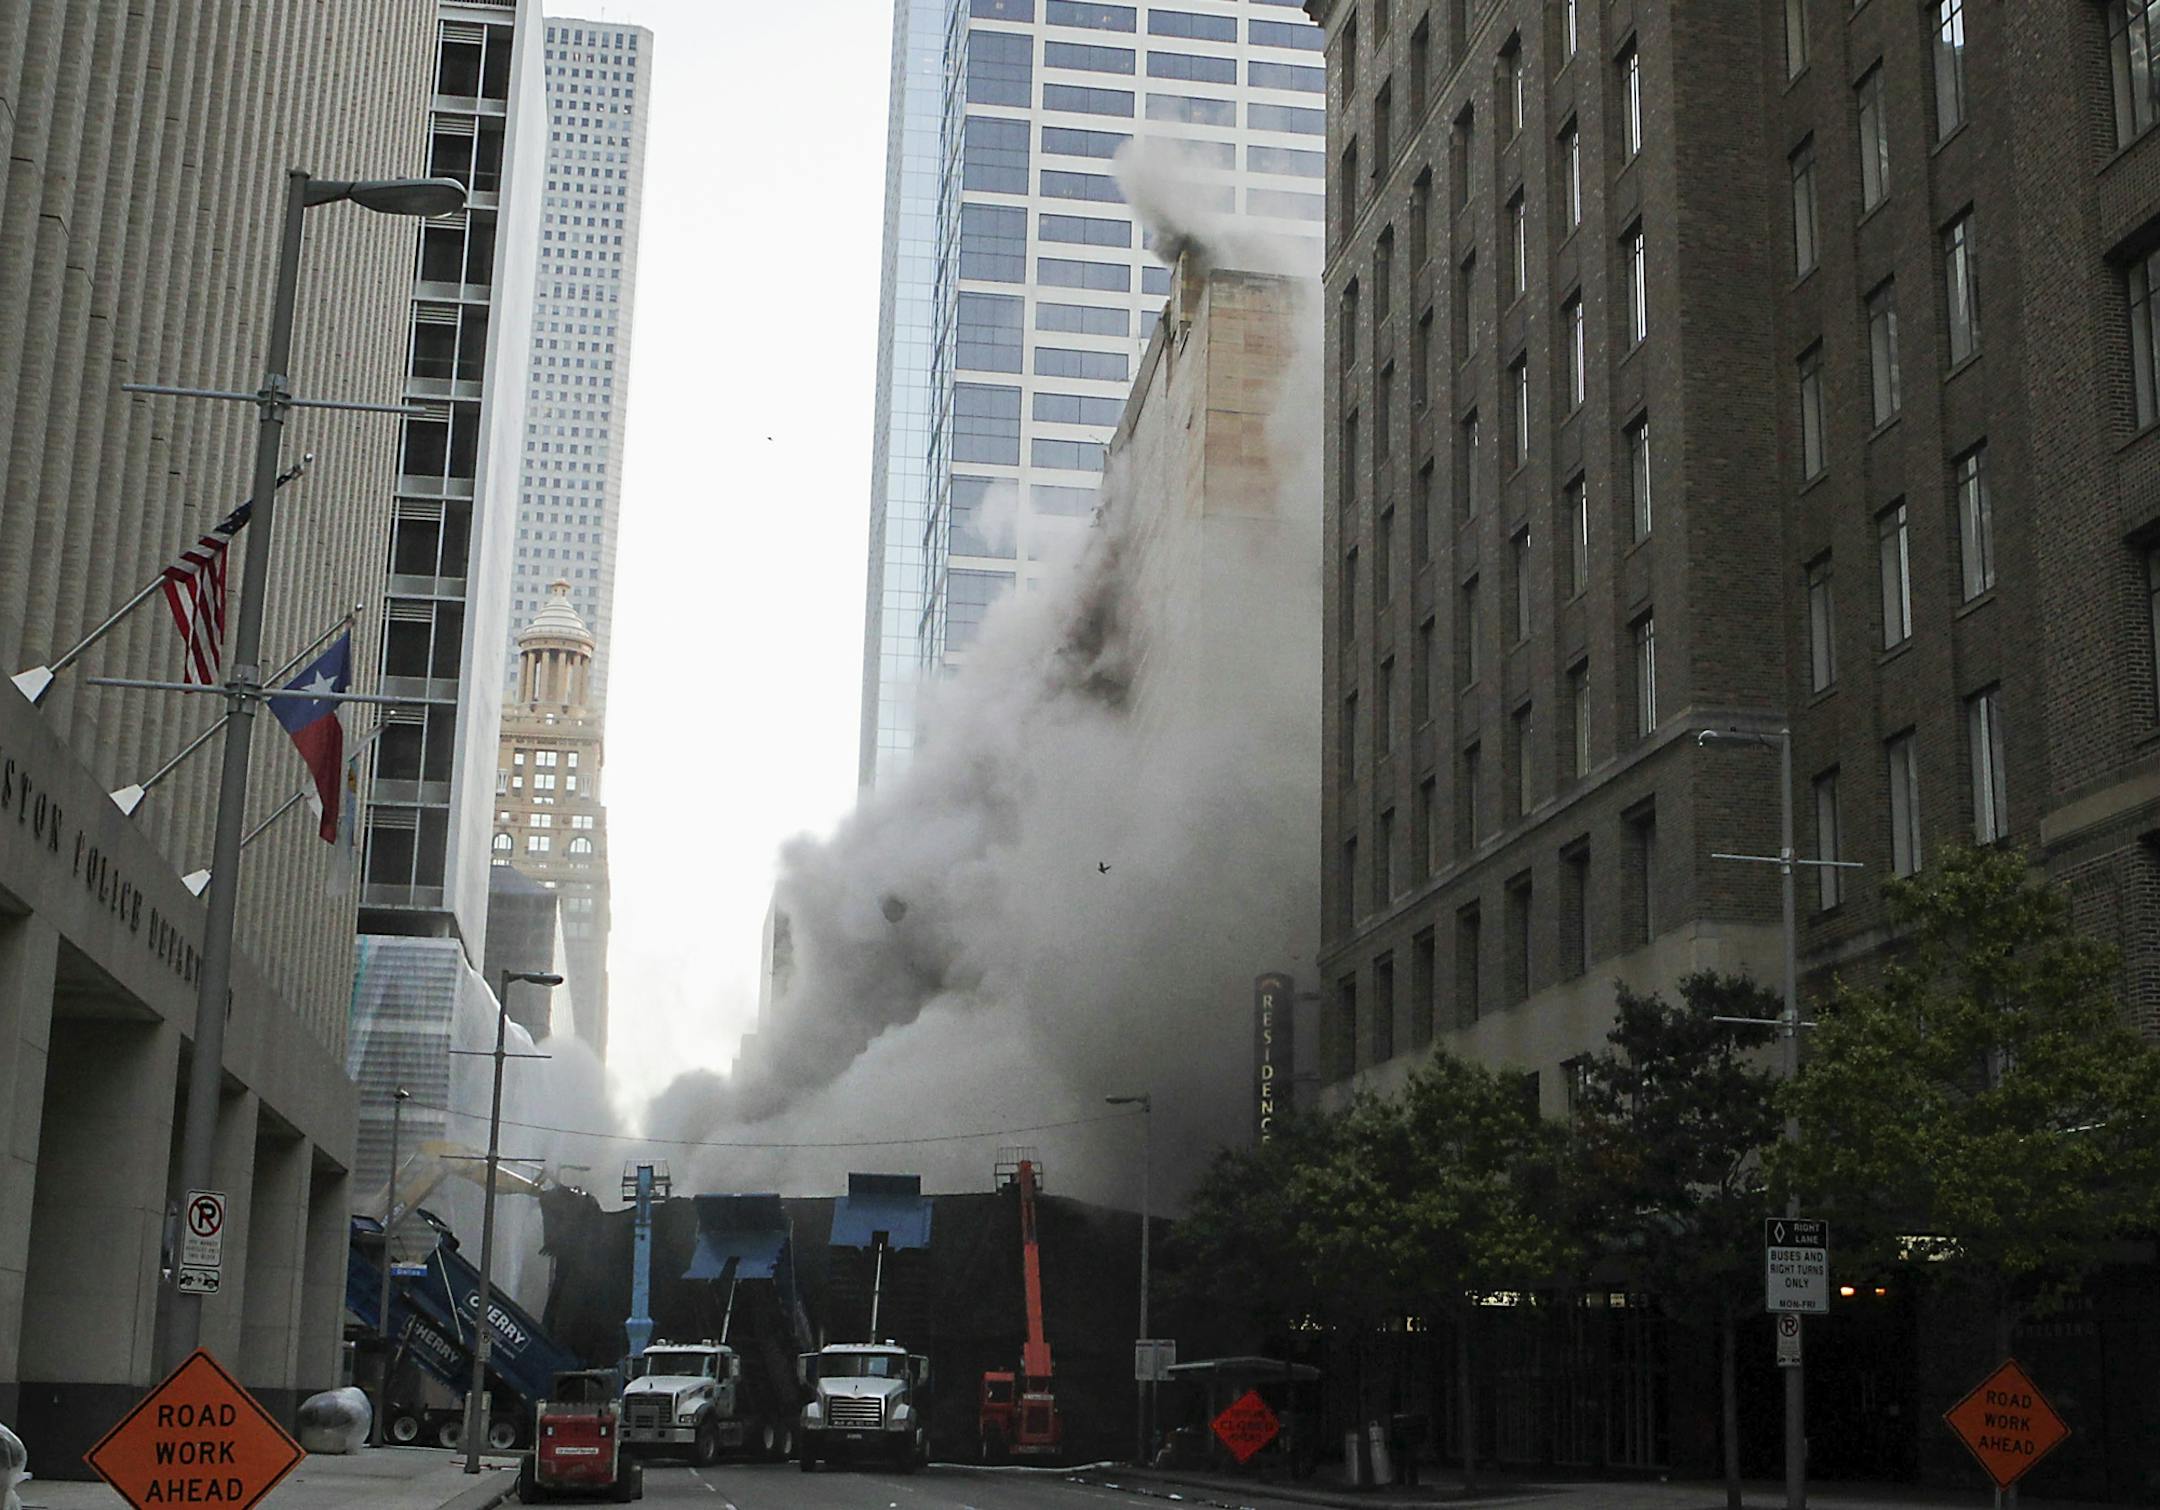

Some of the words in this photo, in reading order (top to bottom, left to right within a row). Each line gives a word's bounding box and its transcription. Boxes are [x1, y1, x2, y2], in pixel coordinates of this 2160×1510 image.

[73, 829, 143, 933] POLICE
[1793, 1222, 1820, 1233] RIGHT
[1795, 1234, 1819, 1244] LANE
[1770, 1250, 1801, 1262] BUSES
[1804, 1251, 1824, 1263] AND
[1770, 1263, 1795, 1275] RIGHT
[1798, 1264, 1824, 1276] TURNS
[1784, 1277, 1809, 1289] ONLY
[1779, 1299, 1816, 1309] MON-FRI
[468, 1295, 526, 1344] CERRY
[1985, 1389, 2033, 1409] ROAD
[157, 1404, 237, 1428] ROAD
[1983, 1412, 2031, 1432] WORK
[155, 1441, 236, 1465] WORK
[1977, 1435, 2035, 1456] AHEAD
[144, 1477, 244, 1503] AHEAD
